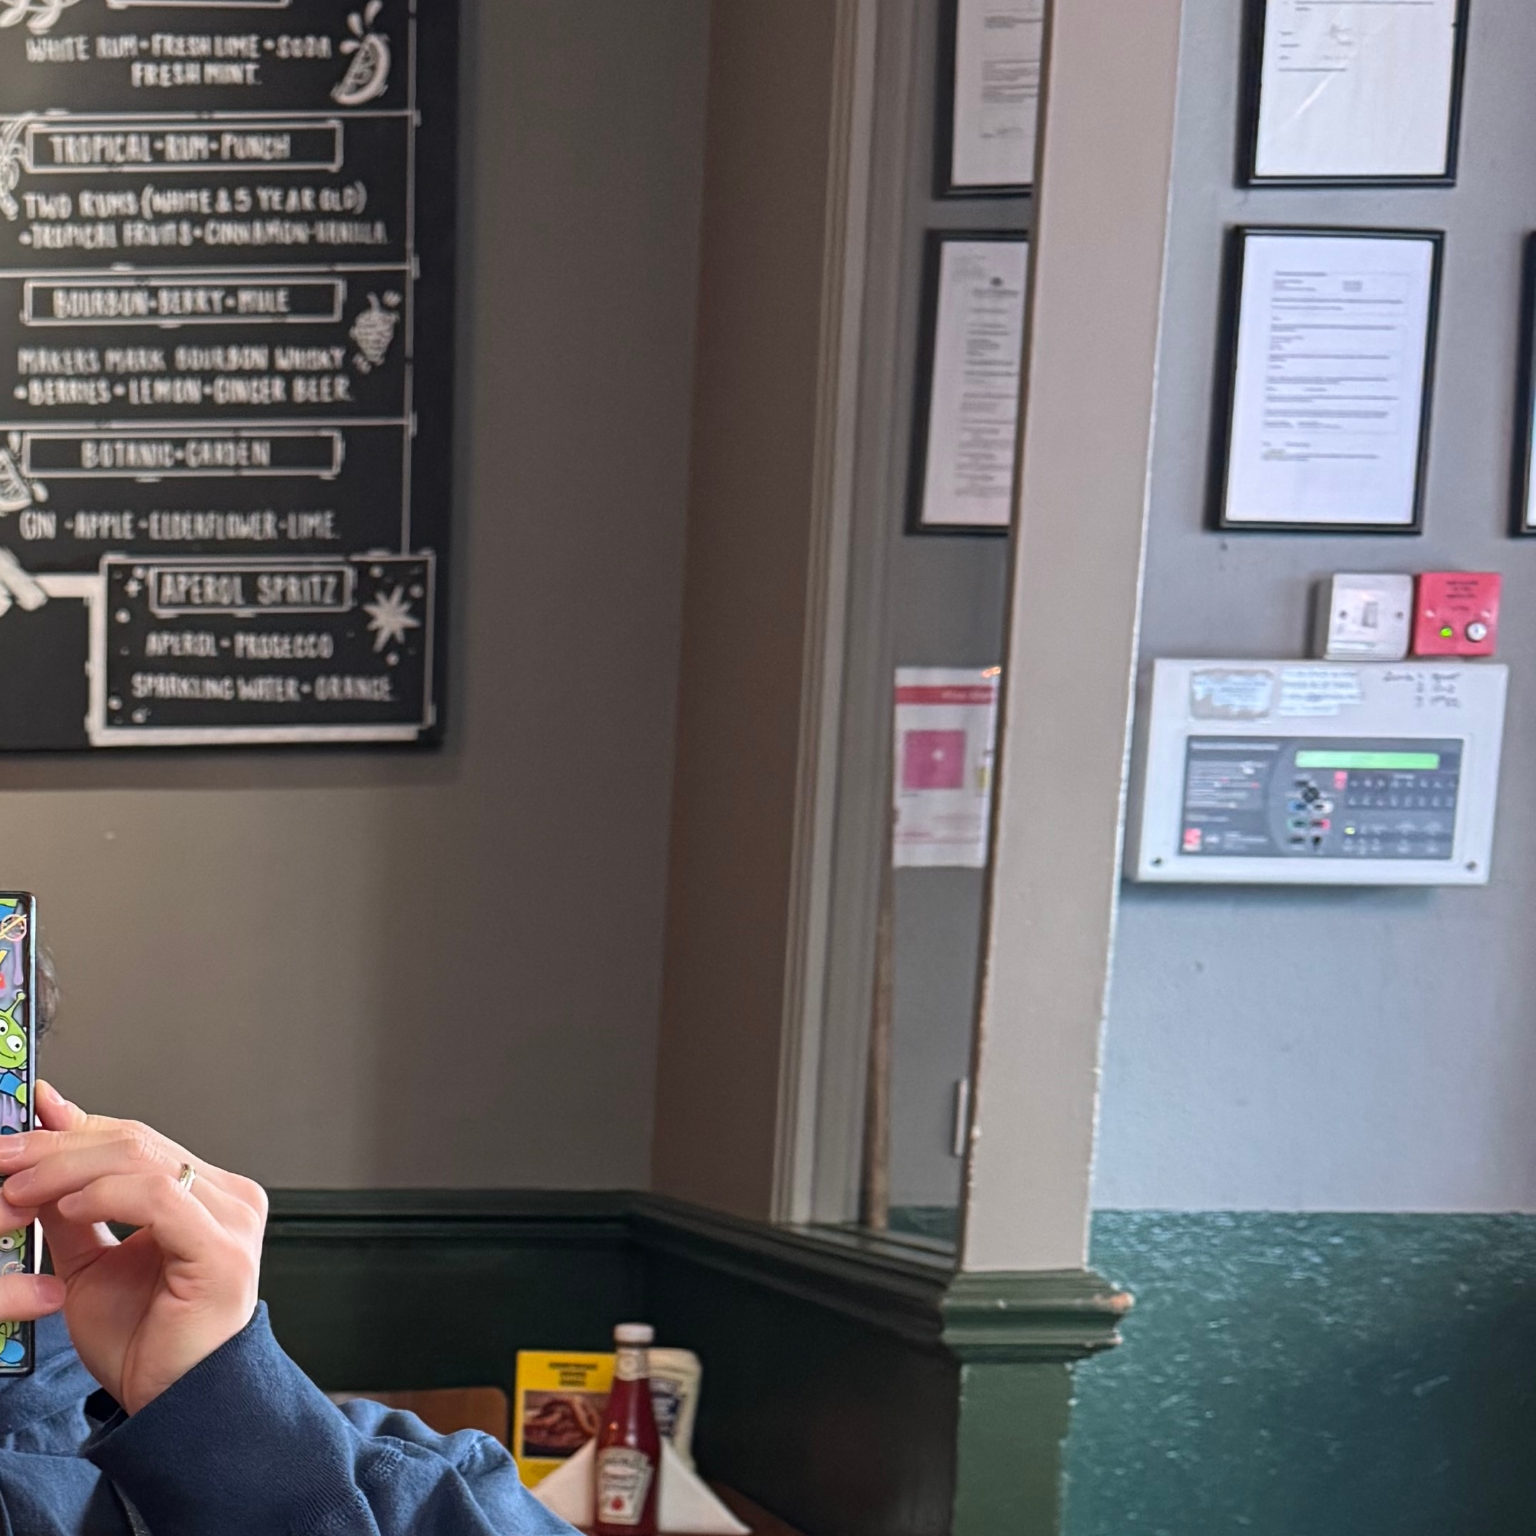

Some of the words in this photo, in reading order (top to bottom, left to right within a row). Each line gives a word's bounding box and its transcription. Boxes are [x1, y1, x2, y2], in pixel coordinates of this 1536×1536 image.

[26, 35, 89, 62] WHITE
[151, 33, 211, 58] FRESH
[214, 34, 261, 59] LIME
[276, 35, 331, 59] SODA
[131, 62, 200, 87] FRESH
[49, 134, 152, 163] TROPICAL
[165, 133, 209, 161] RUM
[221, 132, 291, 160] PUNCH
[22, 191, 72, 219] TWO
[79, 190, 139, 218] RUMS
[234, 187, 252, 213] 5
[256, 186, 315, 213] YEAR
[30, 222, 117, 249] TROPICAL
[123, 219, 192, 247] FRUITS
[204, 218, 309, 246] CINNAMON
[53, 289, 149, 318] BOURBON
[158, 287, 225, 315] BERRY
[237, 287, 291, 314] MULE
[18, 347, 100, 375] MAKERS
[105, 347, 167, 374] MARK
[175, 345, 268, 371] BOURBON
[28, 378, 112, 406] BERRIES
[128, 376, 202, 405] LEMON
[214, 375, 286, 404] GINGER
[81, 440, 174, 469] BOTANIC
[186, 438, 270, 467] GARDEN
[19, 510, 56, 540] GIN
[74, 509, 136, 540] APPLE
[148, 509, 278, 540] ELDERFLOWER
[161, 574, 245, 605] APEROL
[257, 574, 337, 604] SPRITZ
[145, 631, 218, 657] APEROL
[234, 631, 334, 659] PROSECCO
[131, 672, 235, 699] SPARKLING
[236, 674, 301, 701] WATER
